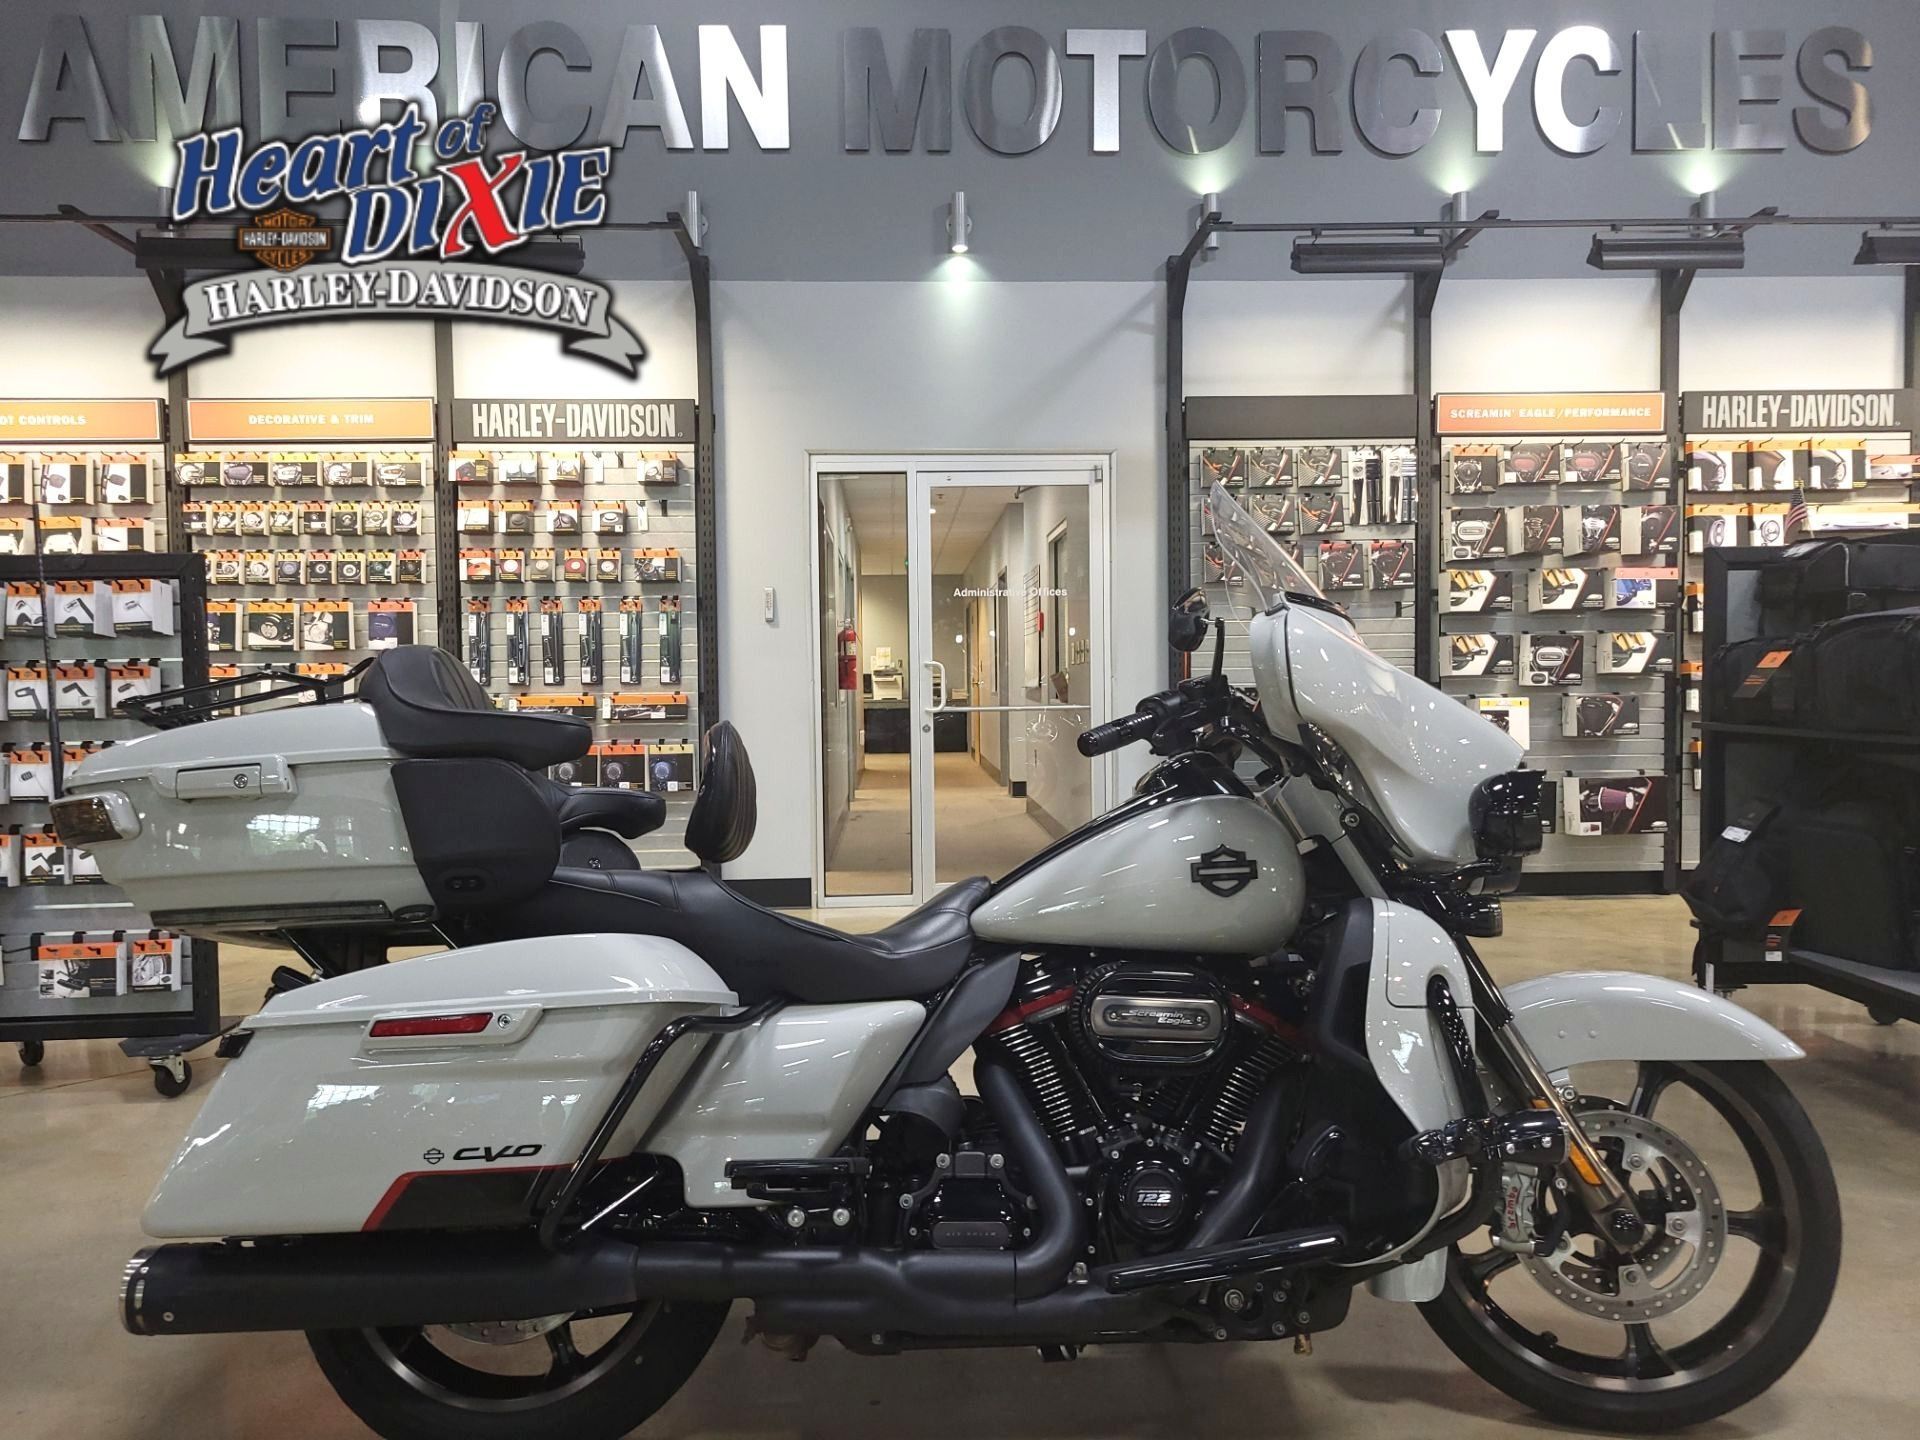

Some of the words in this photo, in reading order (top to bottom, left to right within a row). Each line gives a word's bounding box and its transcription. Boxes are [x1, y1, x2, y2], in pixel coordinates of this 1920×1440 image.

[17, 14, 790, 151] AMERICAN
[843, 24, 1875, 156] MOTORCYCLES
[1702, 393, 1895, 429] HARLEY-DAVIDSON
[18, 415, 88, 426] CONTROLS
[248, 414, 326, 425] DECORATIVE
[344, 414, 375, 424] TRIM
[472, 403, 676, 438] HARLEY-DAVIDSON
[1030, 587, 1068, 597] Offices
[453, 1144, 543, 1162] CVO
[1137, 1193, 1172, 1203] 122
